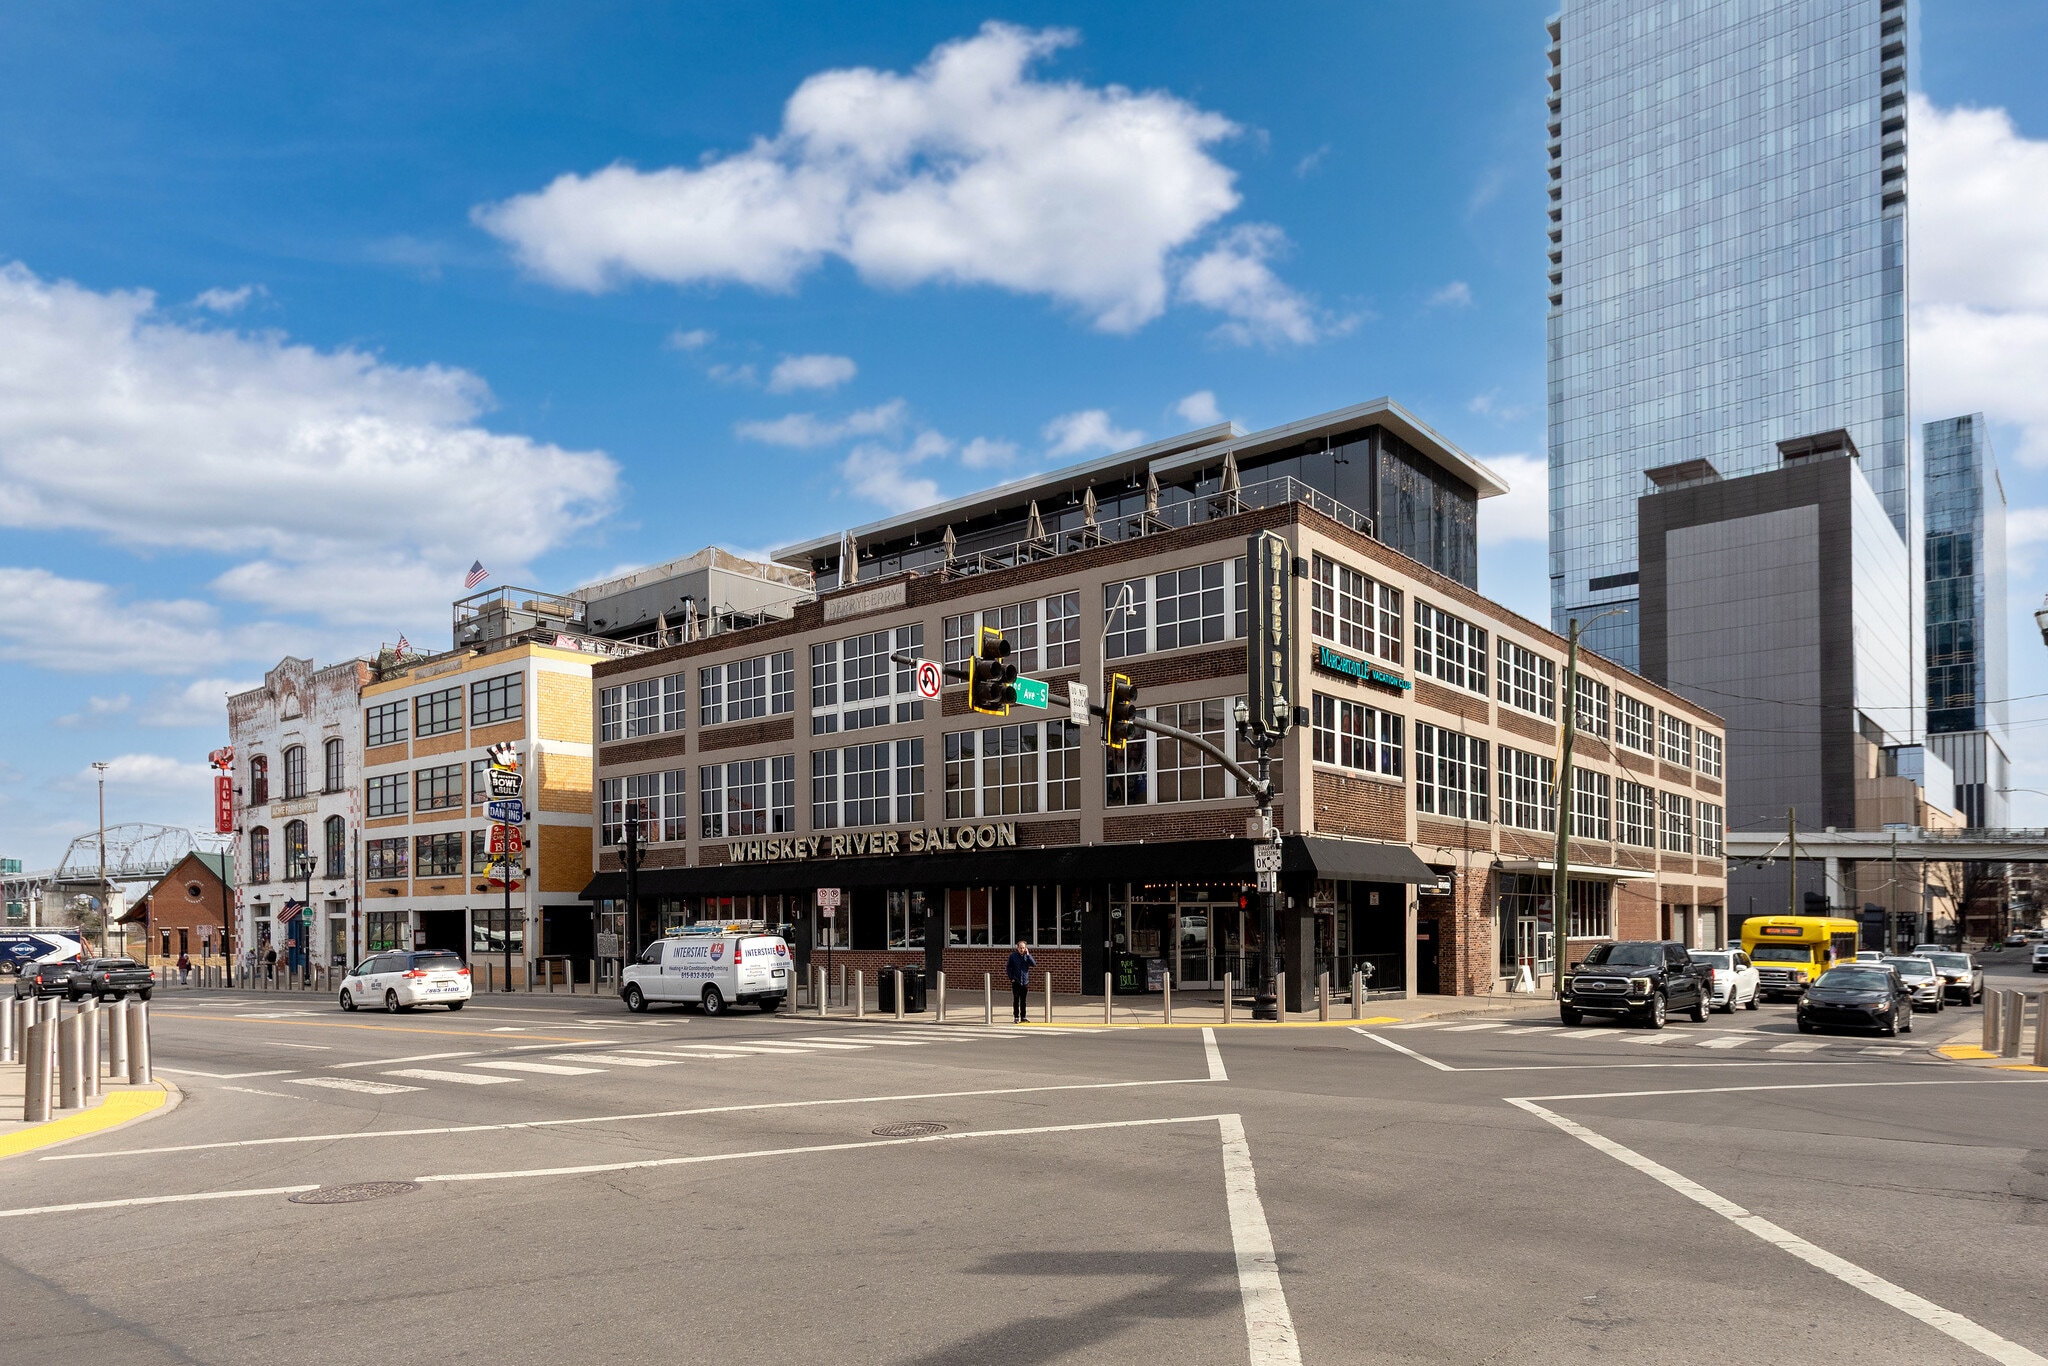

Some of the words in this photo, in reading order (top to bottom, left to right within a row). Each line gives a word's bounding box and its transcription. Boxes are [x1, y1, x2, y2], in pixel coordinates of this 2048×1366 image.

[1269, 538, 1283, 646] WHISKEY
[828, 589, 898, 616] DERRYBERRY
[1321, 646, 1370, 680] MARGARITAVILLE
[1372, 670, 1398, 686] VACATION
[1398, 679, 1412, 691] CLUB
[1024, 688, 1035, 700] Ave
[1040, 688, 1046, 702] S
[493, 778, 518, 787] BOWL
[222, 779, 231, 821] ACME
[490, 807, 521, 821] DANING
[728, 835, 822, 862] WHISKEY
[831, 831, 900, 857] RIVER
[909, 822, 1017, 851] SALOON
[1256, 858, 1266, 868] OK
[673, 947, 708, 957] INTERSTATE
[745, 947, 776, 957] INTERSTATE
